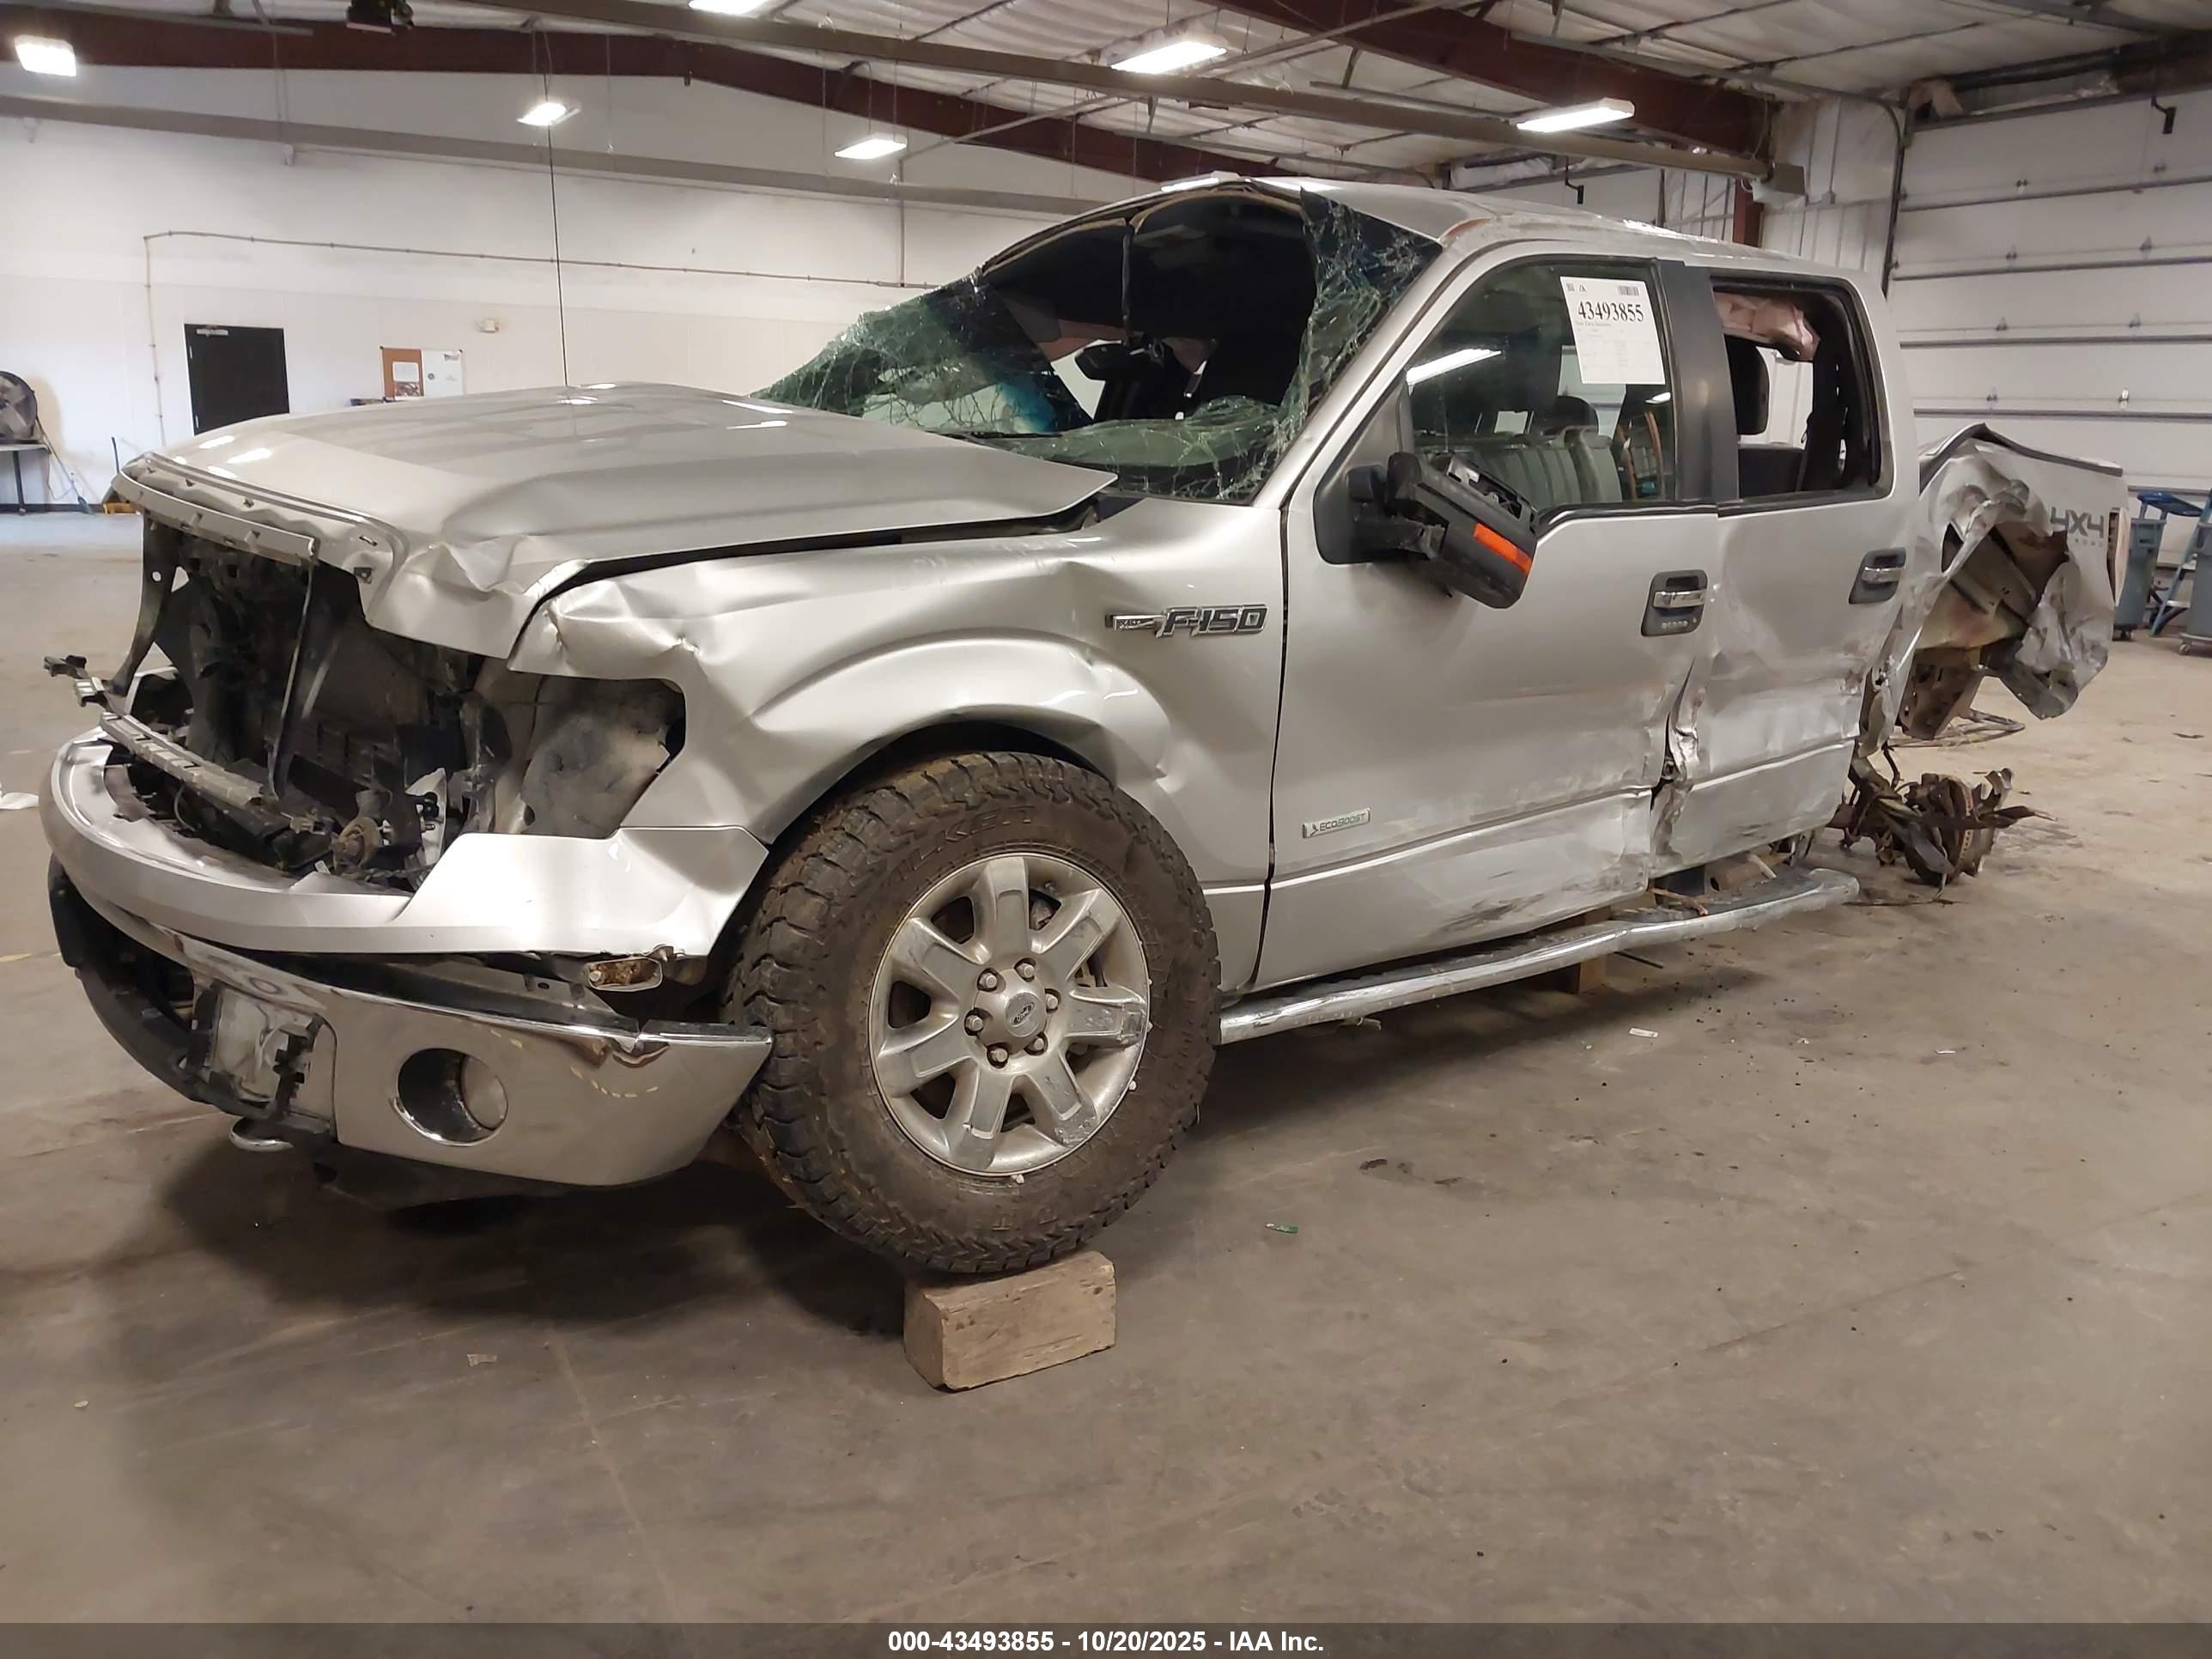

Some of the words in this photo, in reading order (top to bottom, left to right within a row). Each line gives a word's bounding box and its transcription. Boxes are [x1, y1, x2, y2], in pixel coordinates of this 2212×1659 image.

[1578, 301, 1644, 323] 43493855
[2051, 507, 2105, 538] 4X4
[1156, 605, 1269, 638] F-150
[1319, 812, 1366, 832] ECOBOOST
